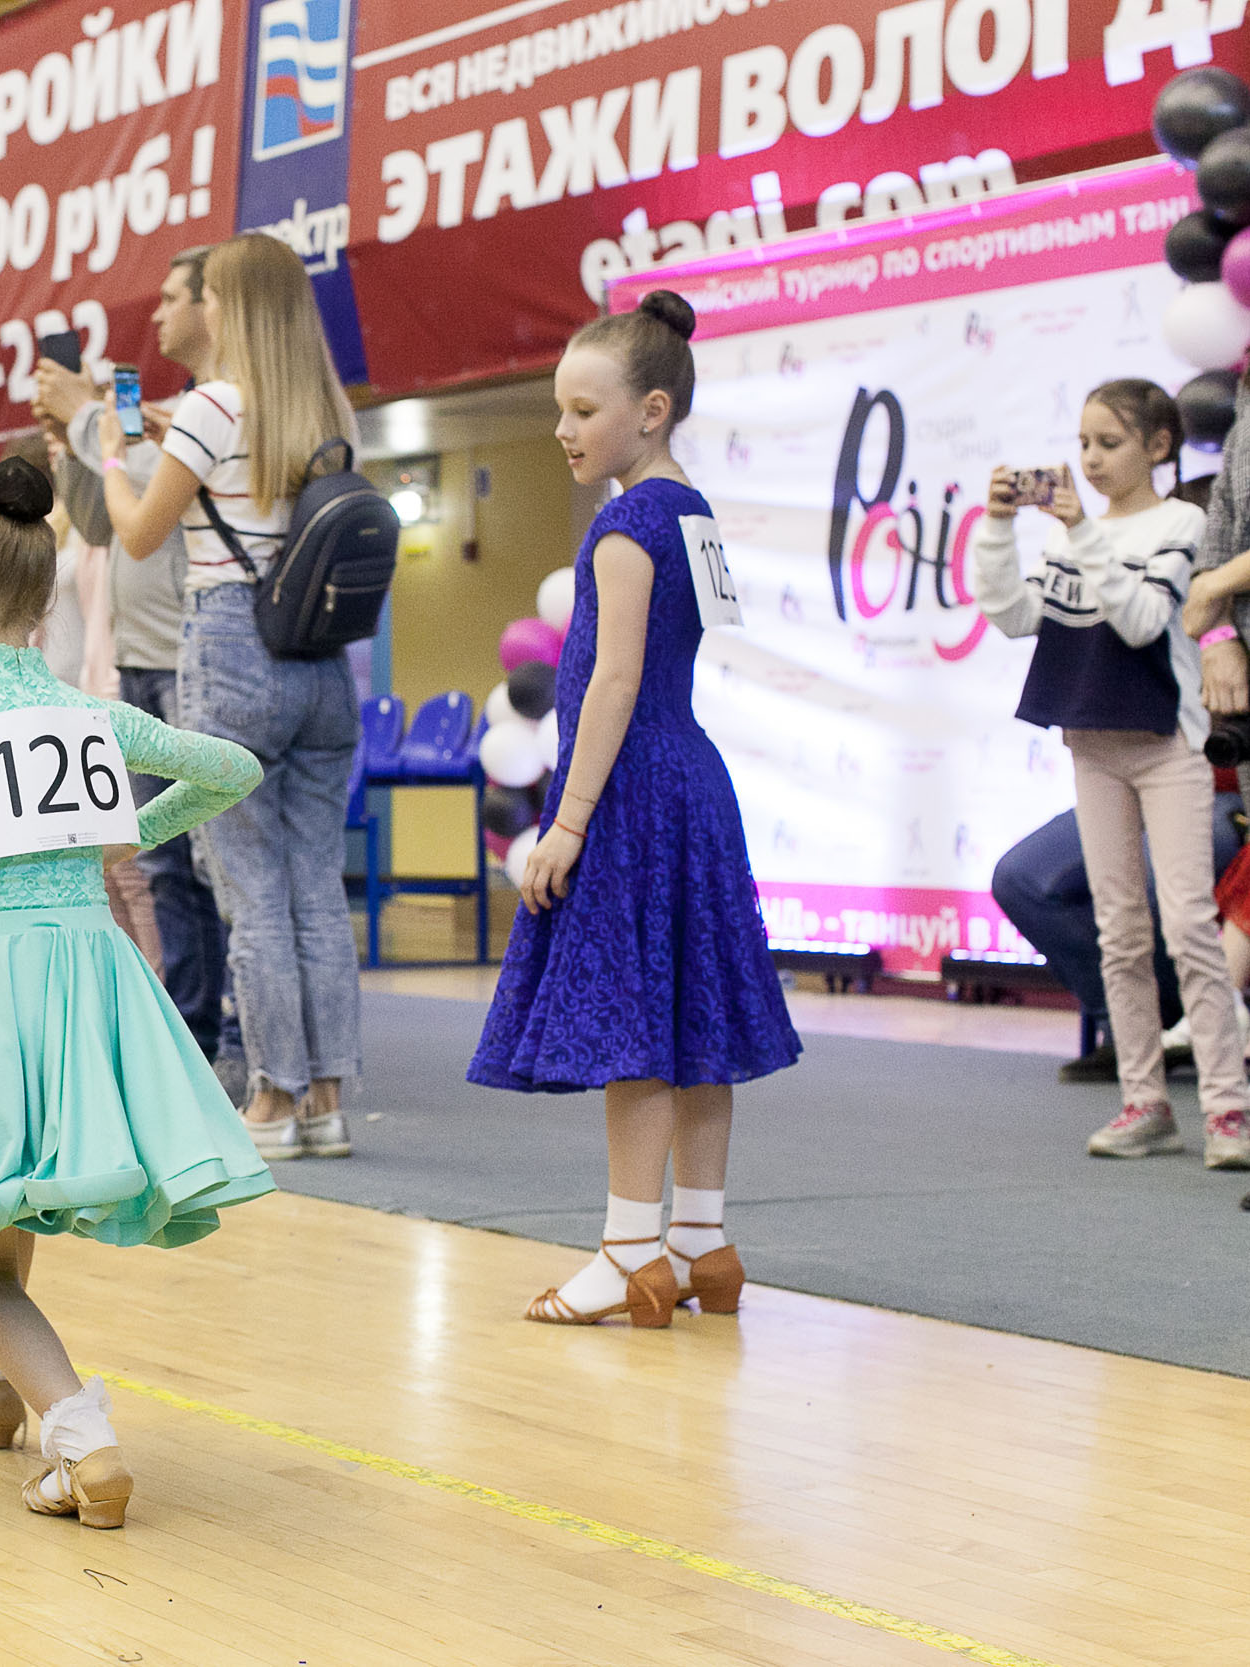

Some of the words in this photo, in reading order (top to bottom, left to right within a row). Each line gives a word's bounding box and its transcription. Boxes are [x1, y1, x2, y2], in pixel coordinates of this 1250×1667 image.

[377, 66, 702, 244] ЭТАЖИ
[718, 0, 1247, 160] ВОЛОГД
[385, 60, 456, 122] ВСЯ
[456, 0, 771, 99] НЕДВИЖИМО
[52, 124, 217, 282] руб.!
[580, 148, 1017, 304] etaicom
[881, 246, 920, 279] по
[924, 209, 1116, 271] спортивным
[700, 538, 737, 602] 12
